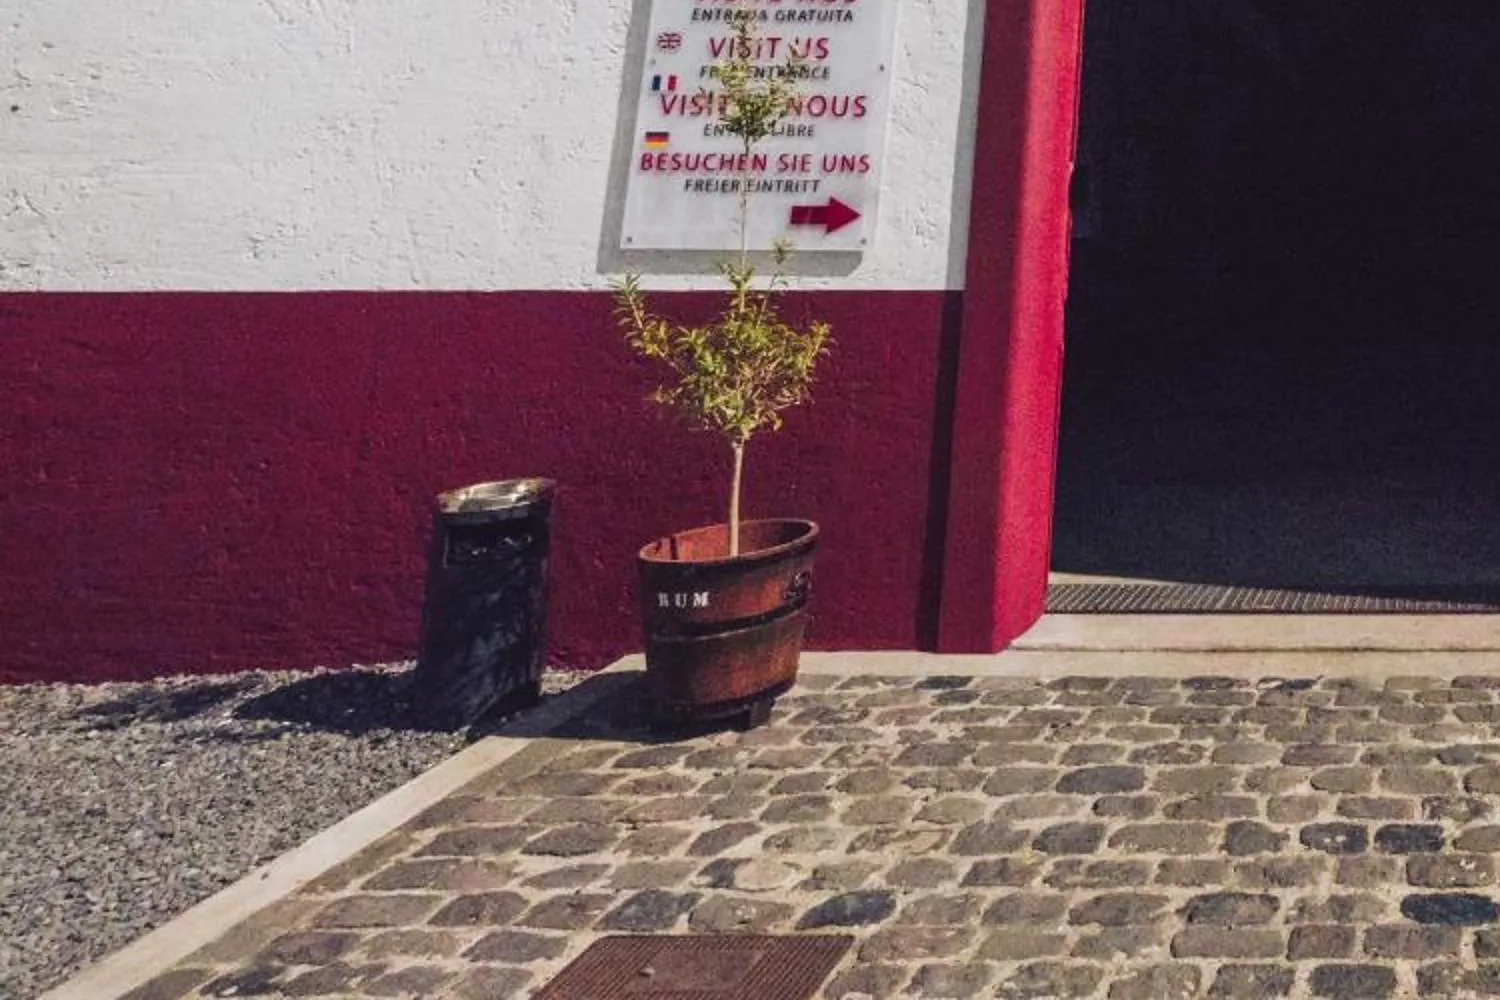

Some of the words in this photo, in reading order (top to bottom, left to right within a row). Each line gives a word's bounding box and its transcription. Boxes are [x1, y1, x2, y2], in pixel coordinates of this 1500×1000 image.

[775, 9, 853, 23] GRATUITA
[640, 152, 767, 172] BESUCHEN
[776, 153, 812, 172] SIE
[822, 154, 870, 174] UNS
[684, 179, 740, 193] FREIER
[746, 179, 821, 193] EINTRITT
[657, 591, 710, 608] RUM
